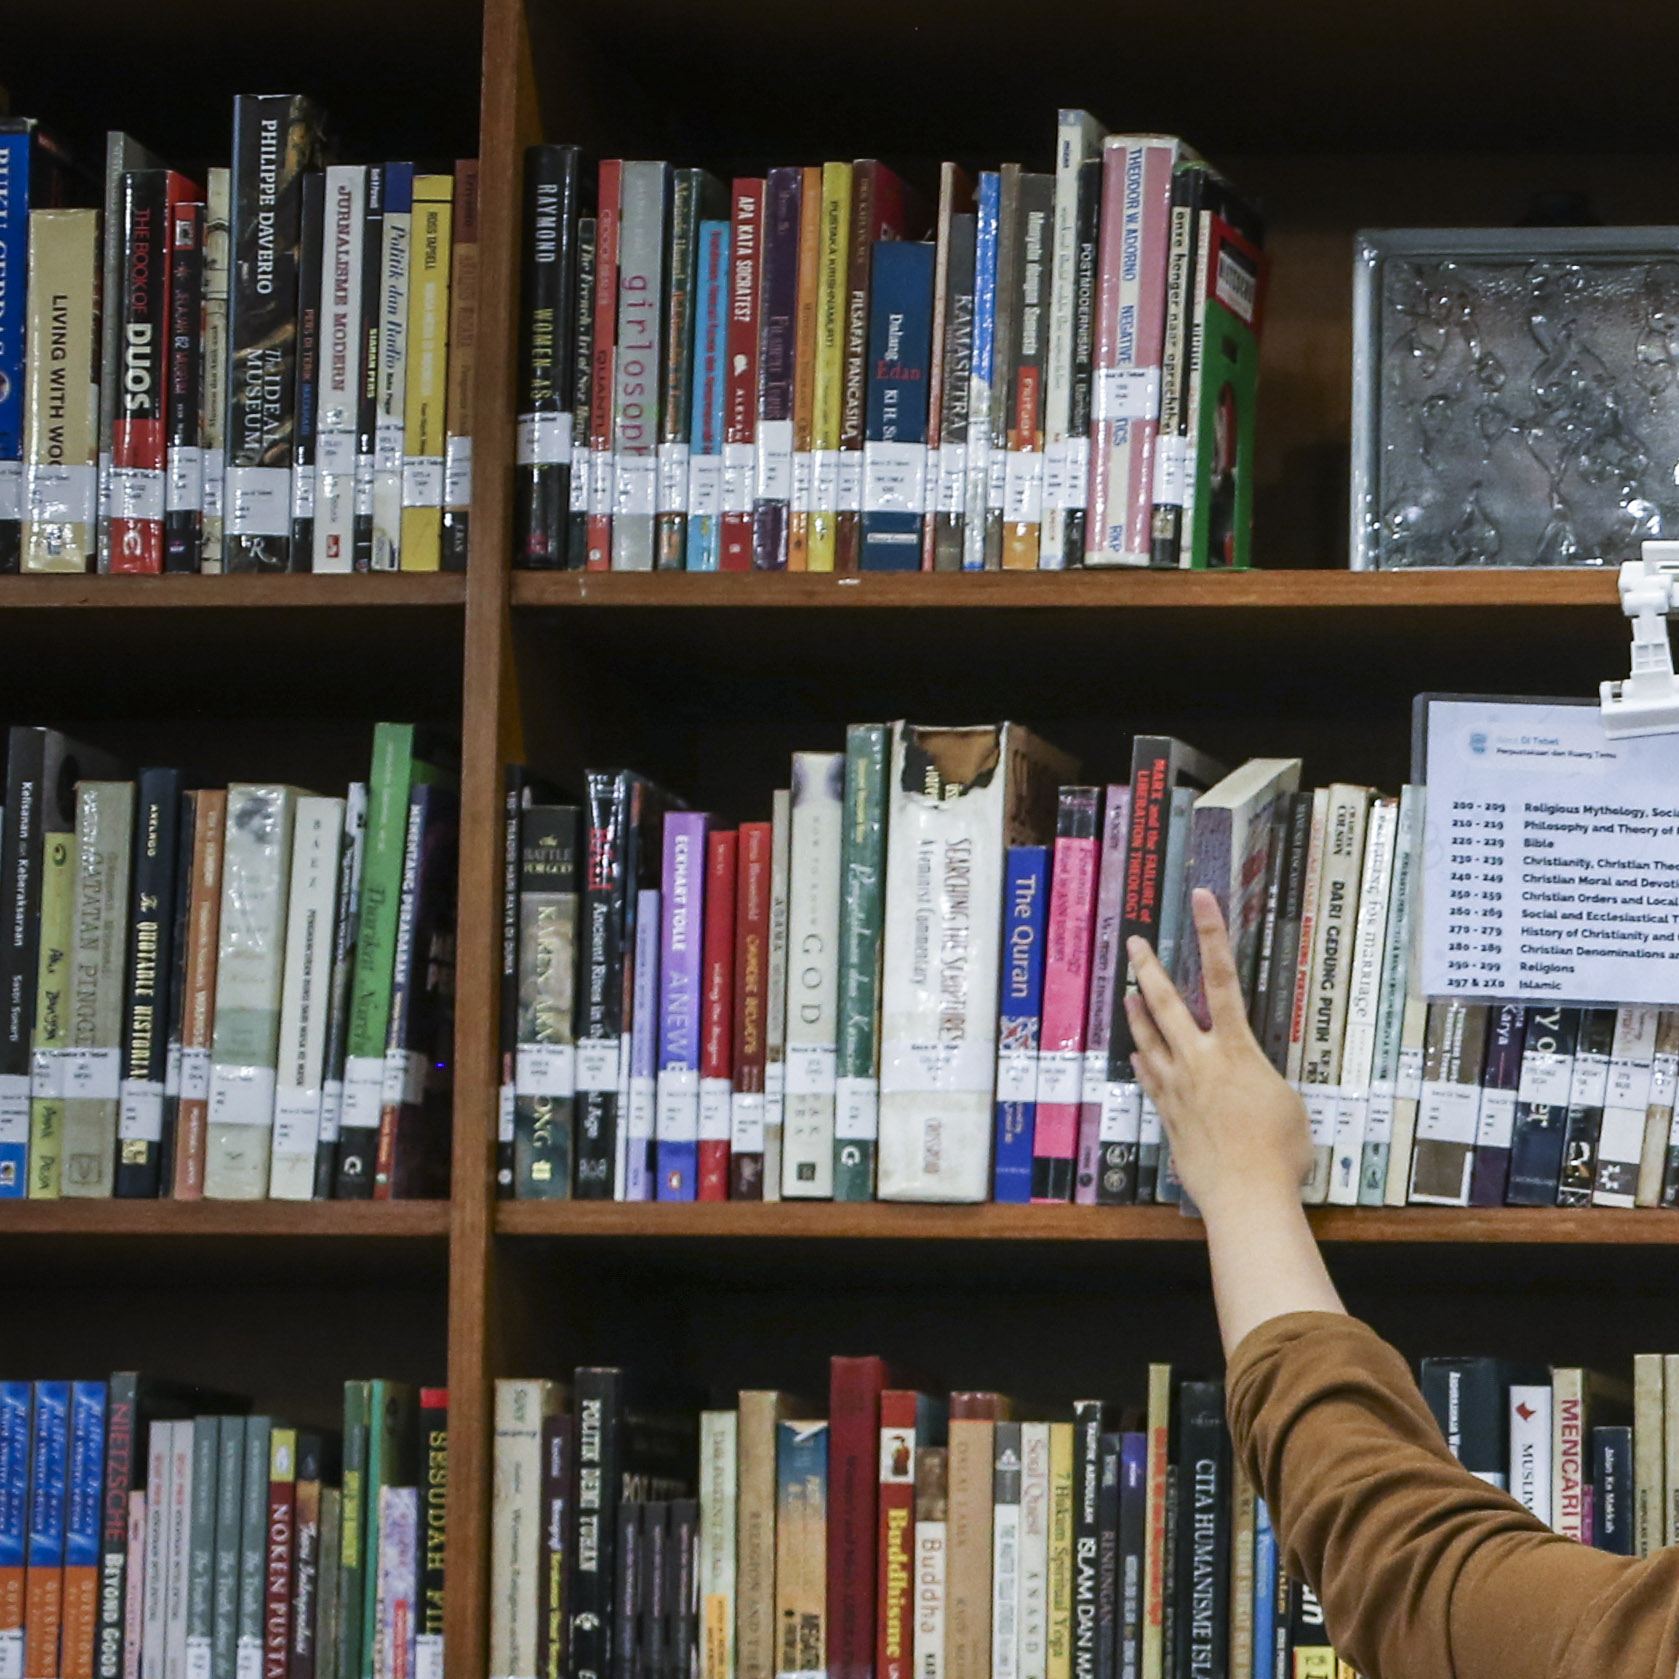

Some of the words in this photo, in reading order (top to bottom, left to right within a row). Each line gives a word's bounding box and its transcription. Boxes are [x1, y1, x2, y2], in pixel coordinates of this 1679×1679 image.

[259, 119, 277, 206] PHILIPPE
[737, 196, 754, 220] APA
[334, 185, 352, 306] JURNALISME
[736, 225, 753, 255] KATA
[256, 212, 274, 295] DAVERIO
[734, 259, 752, 322] SOCRATES?
[331, 313, 348, 392] MODERN
[1525, 804, 1579, 815] Religious
[1583, 805, 1648, 818] Mythology,
[1524, 821, 1588, 834] Philosophy
[1592, 824, 1614, 833] and
[1618, 824, 1658, 837] Theory
[1662, 825, 1673, 835] of
[1524, 839, 1554, 848] Bible
[672, 835, 688, 903] ECKHART
[1523, 857, 1594, 869] Christianity,
[1597, 859, 1650, 870] Christian
[1523, 874, 1574, 884] Christian
[1579, 876, 1611, 885] Moral
[1615, 878, 1637, 887] and
[1522, 892, 1574, 902] Christian
[1578, 894, 1617, 904] Orders
[1621, 896, 1643, 905] and
[1647, 897, 1678, 906] Local
[1522, 910, 1557, 919] Social
[1561, 912, 1583, 920] and
[1586, 912, 1668, 924] Ecclesiastical
[672, 908, 687, 950] TOLLE
[1521, 927, 1563, 939] History
[1567, 929, 1578, 937] of
[1581, 929, 1649, 942] Christianity
[1652, 933, 1674, 942] and
[1521, 945, 1573, 955] Christian
[1576, 946, 1665, 959] Denominations
[1520, 962, 1574, 974] Religions
[1520, 980, 1560, 990] Islamic
[105, 1403, 131, 1540] NIETZSCHE
